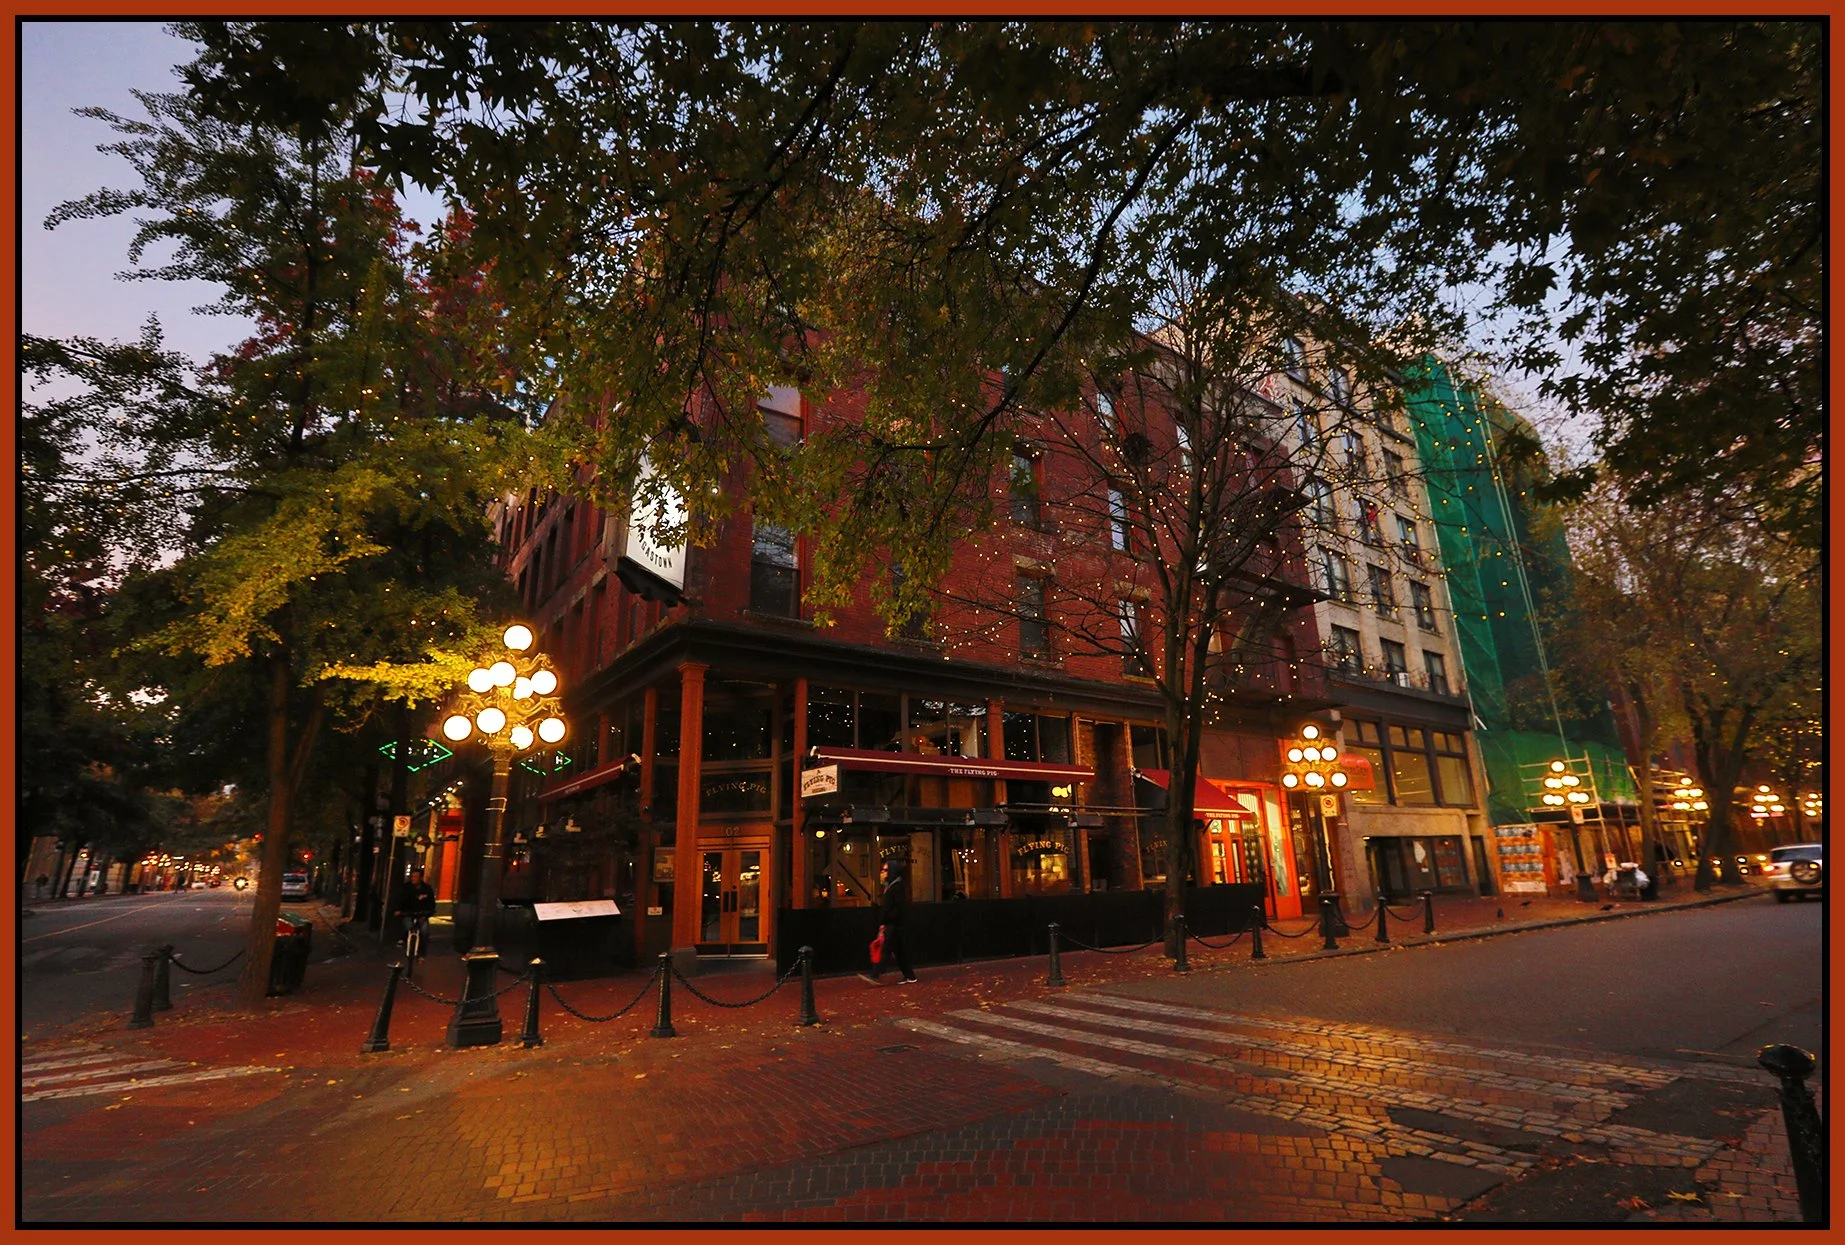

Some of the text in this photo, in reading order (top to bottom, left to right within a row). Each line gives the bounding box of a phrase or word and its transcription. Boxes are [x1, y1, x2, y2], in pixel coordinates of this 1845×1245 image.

[641, 541, 673, 569] GASTOWN
[706, 781, 767, 797] FLYING PIG
[1017, 840, 1070, 856] FLYING PIG
